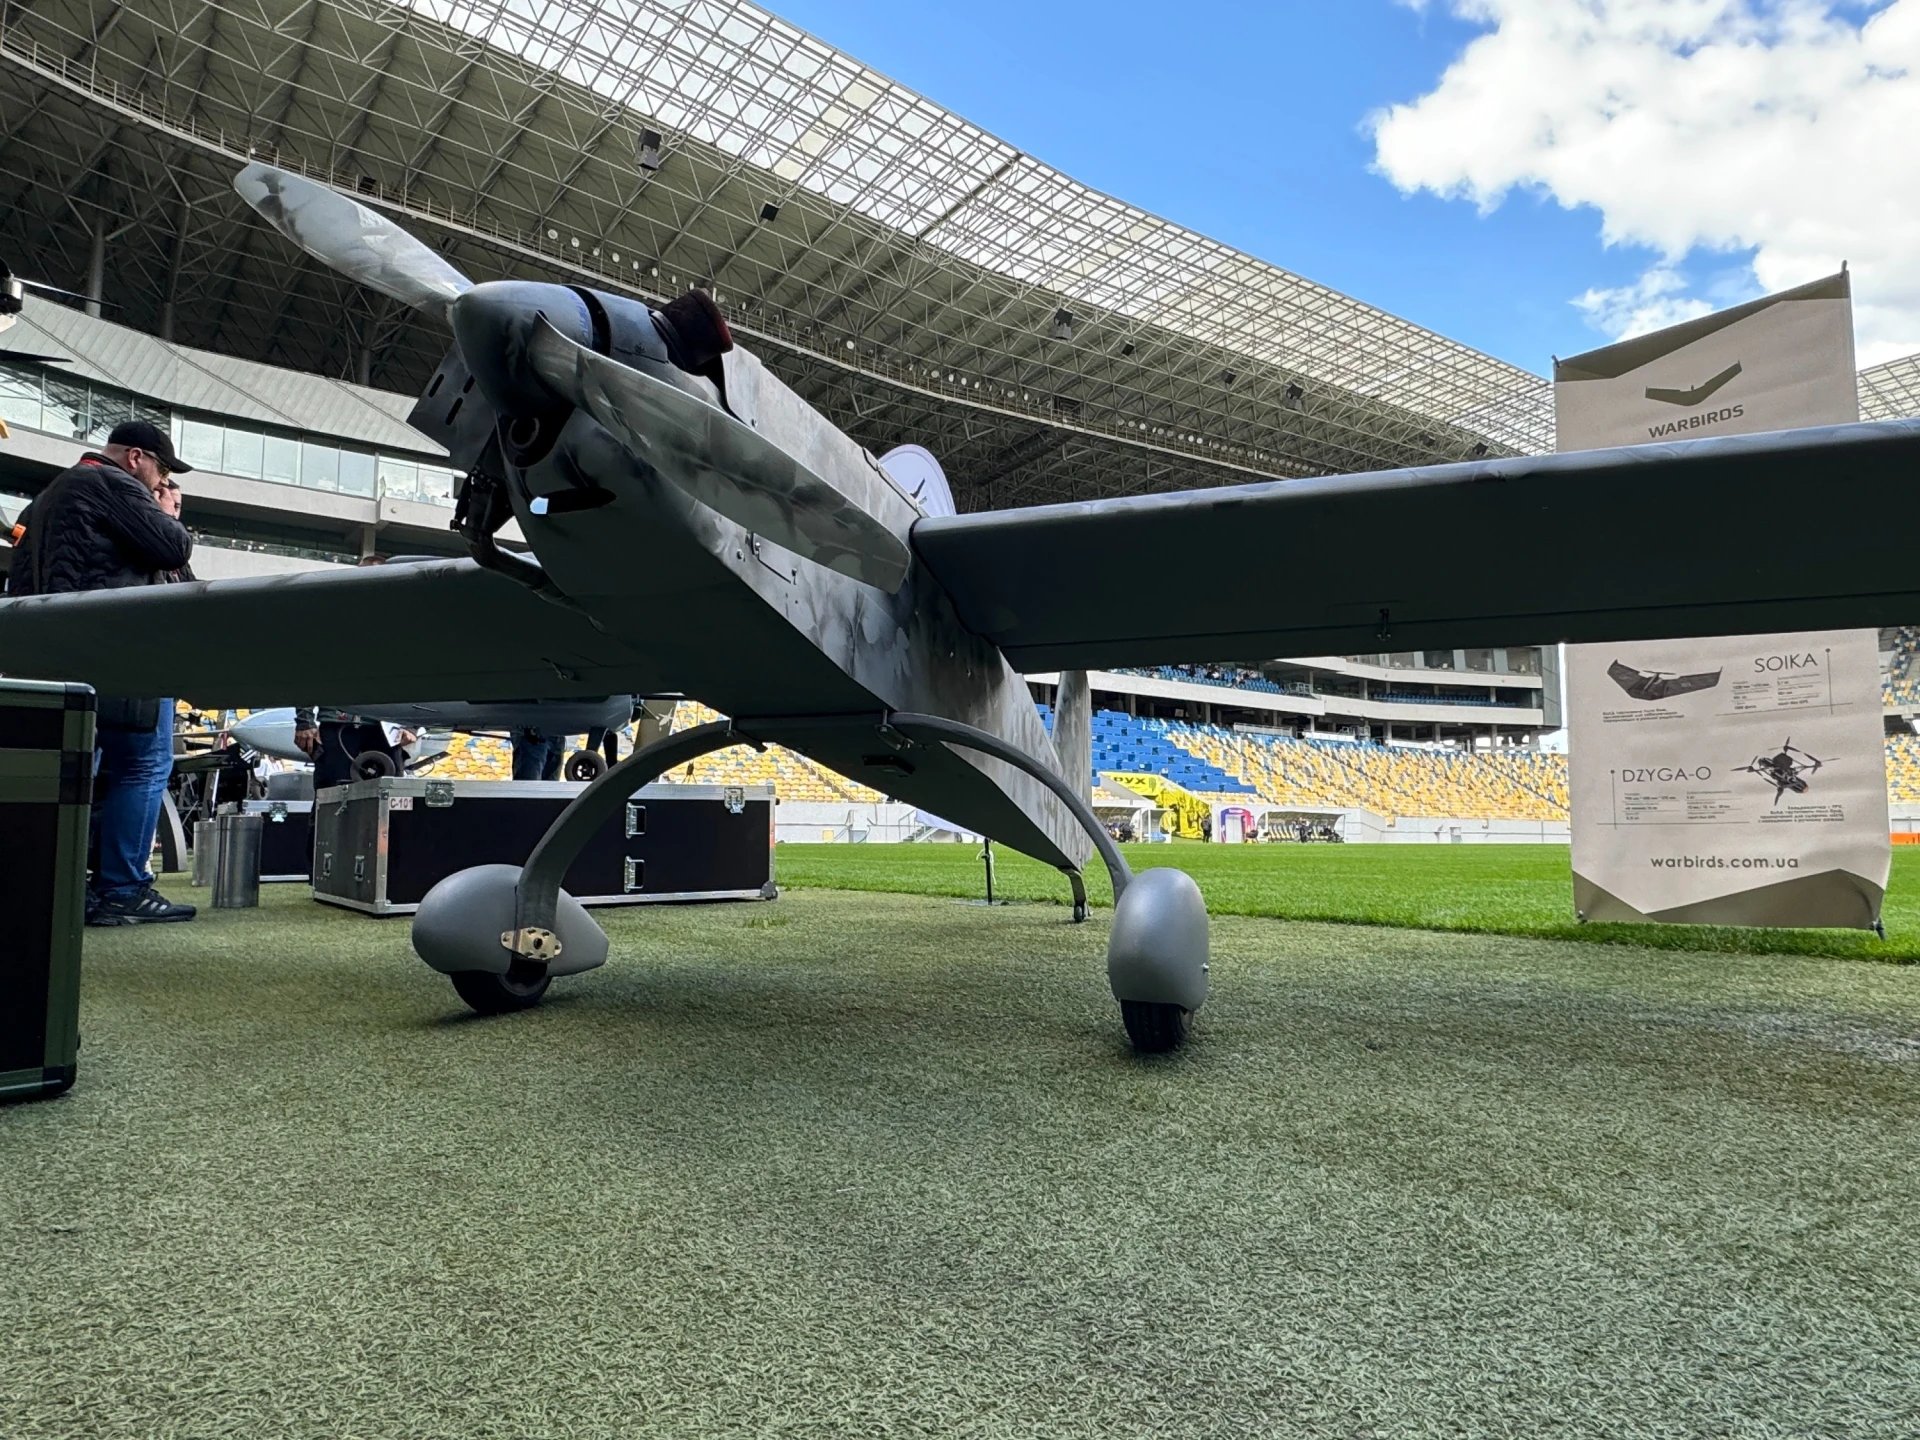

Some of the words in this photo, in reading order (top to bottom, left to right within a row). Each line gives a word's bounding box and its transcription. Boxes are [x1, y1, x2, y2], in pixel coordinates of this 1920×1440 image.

[1648, 404, 1744, 438] WARBIRDS
[1754, 653, 1818, 673] SOIKA
[1622, 766, 1712, 782] DZYGA-O
[1650, 855, 1799, 868] warbirds.com.ua
